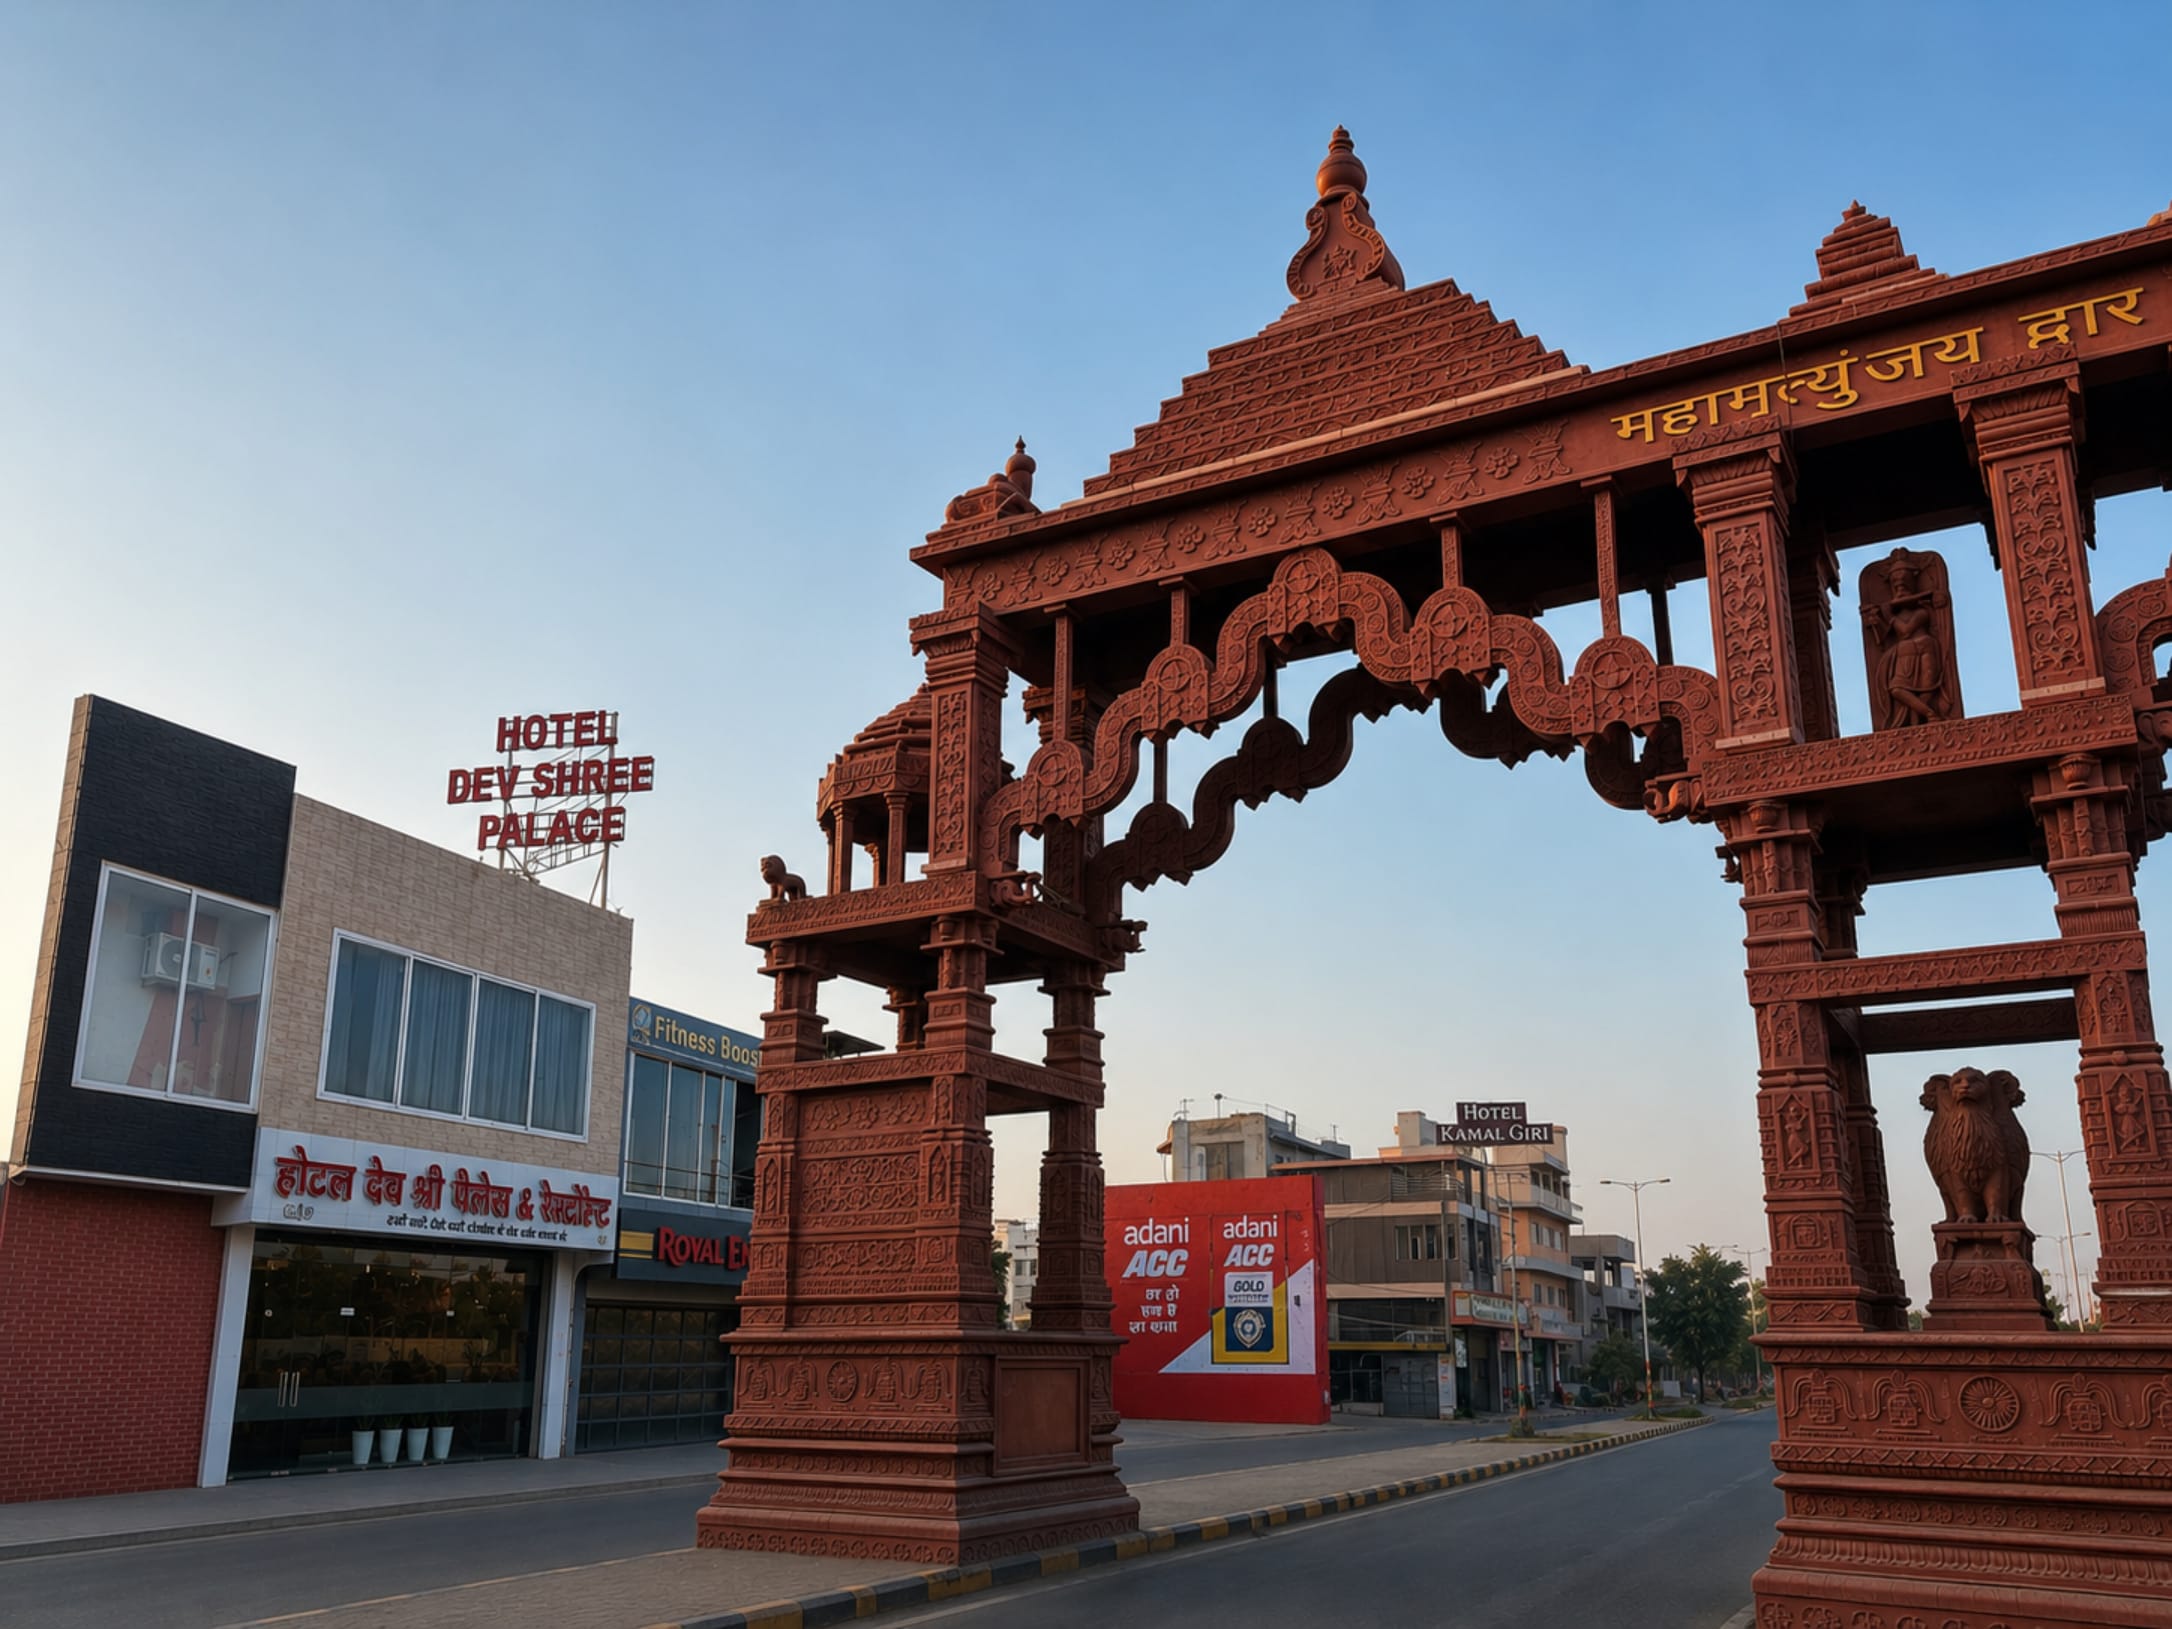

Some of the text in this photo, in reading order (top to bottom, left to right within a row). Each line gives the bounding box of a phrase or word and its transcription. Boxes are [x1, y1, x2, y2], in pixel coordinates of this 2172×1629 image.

[2017, 287, 2144, 349] द्वार
[497, 710, 618, 752] HOTEL
[448, 755, 655, 804] DEV SHREE
[478, 806, 625, 851] PALACE
[654, 1015, 715, 1056] Fitness
[1441, 1124, 1548, 1141] KAMAL GIRI
[1464, 1104, 1522, 1120] HOTEL
[274, 1145, 357, 1201] होटल
[365, 1155, 407, 1206] देव
[411, 1164, 446, 1210] श्री
[517, 1188, 534, 1221] &
[658, 1226, 724, 1267] ROYAL
[1123, 1217, 1189, 1245] adani
[1223, 1214, 1277, 1239] adani
[1121, 1249, 1188, 1278] ACC
[1223, 1243, 1274, 1267] ACC
